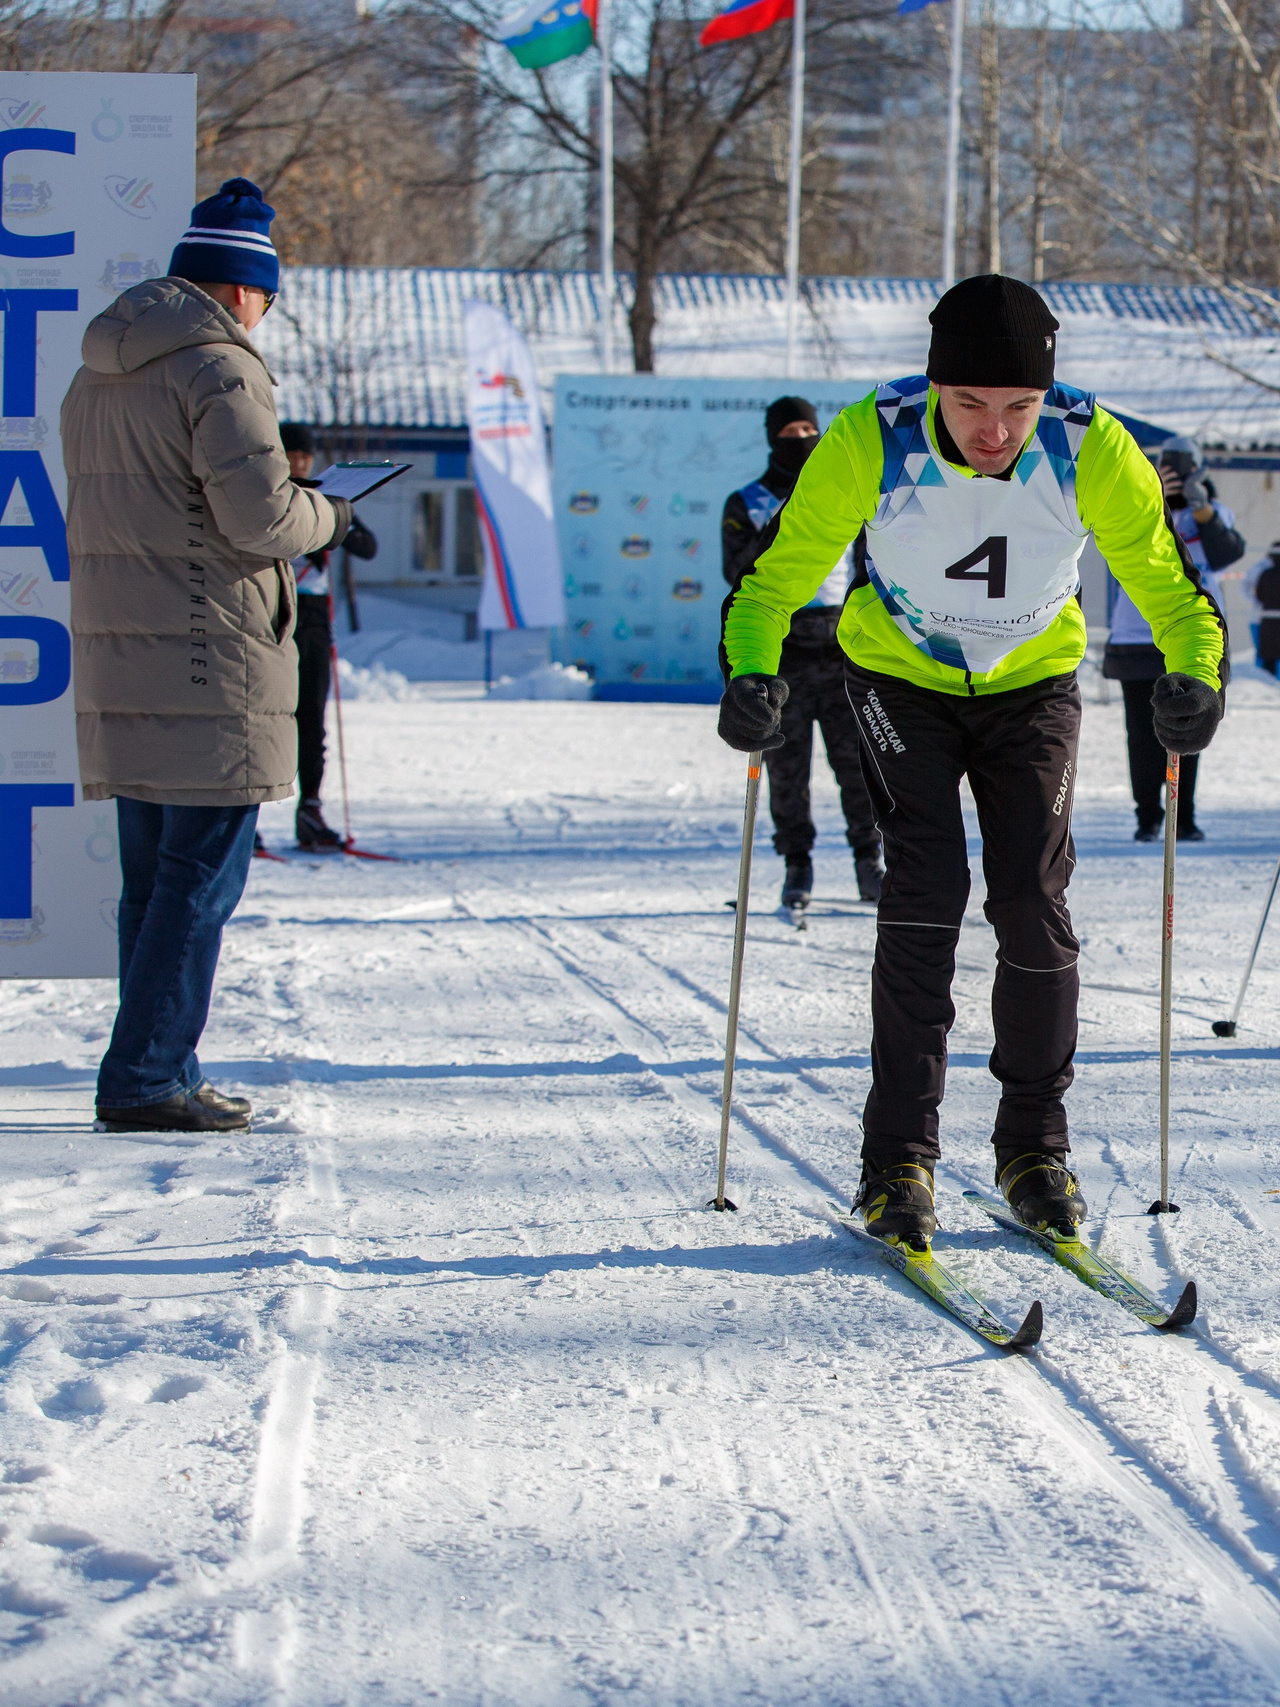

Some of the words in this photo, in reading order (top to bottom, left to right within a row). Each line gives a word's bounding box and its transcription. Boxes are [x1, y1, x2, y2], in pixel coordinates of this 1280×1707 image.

[945, 535, 1007, 599] 4
[189, 561, 208, 686] ATHLETES
[862, 704, 888, 752] ОБЛАСТЬ
[867, 688, 907, 754] ТЮМЕНСКАЯ
[1052, 768, 1070, 816] CRAFT
